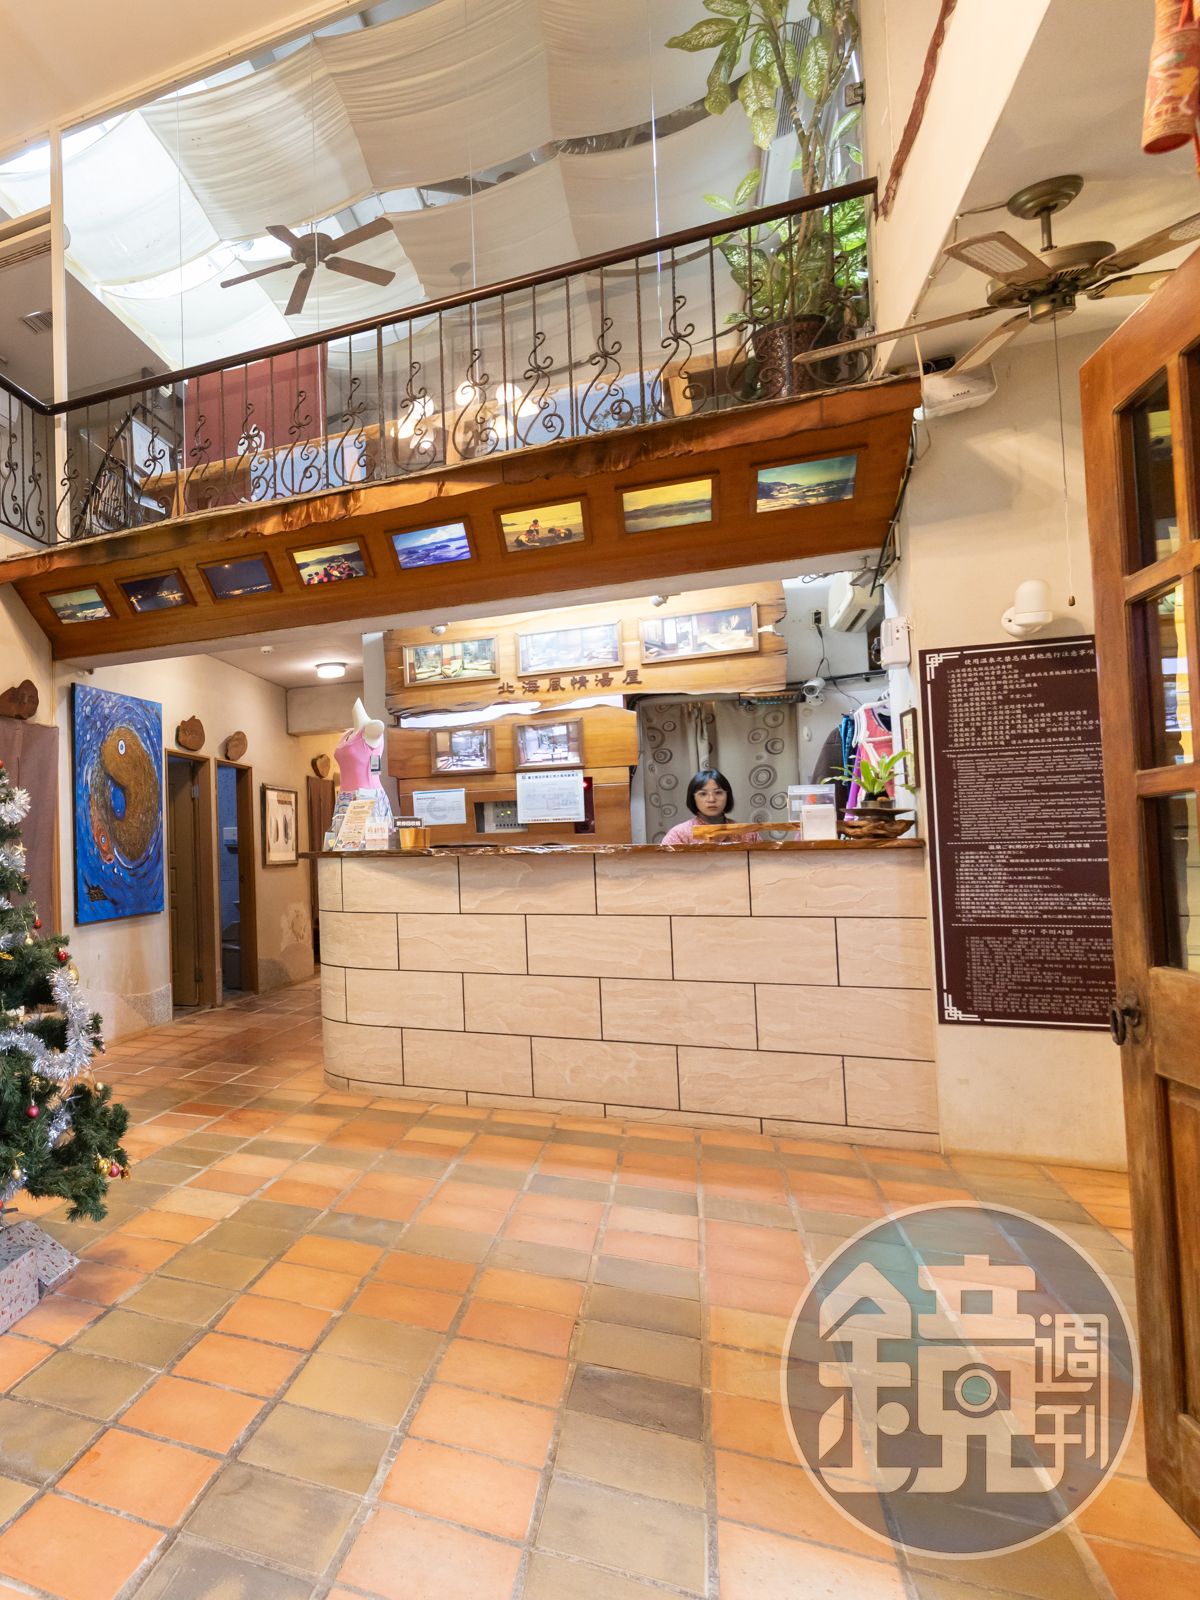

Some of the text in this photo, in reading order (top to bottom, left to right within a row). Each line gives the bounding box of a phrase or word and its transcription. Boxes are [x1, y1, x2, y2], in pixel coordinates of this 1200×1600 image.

[498, 669, 643, 696] 北海風情湯屋
